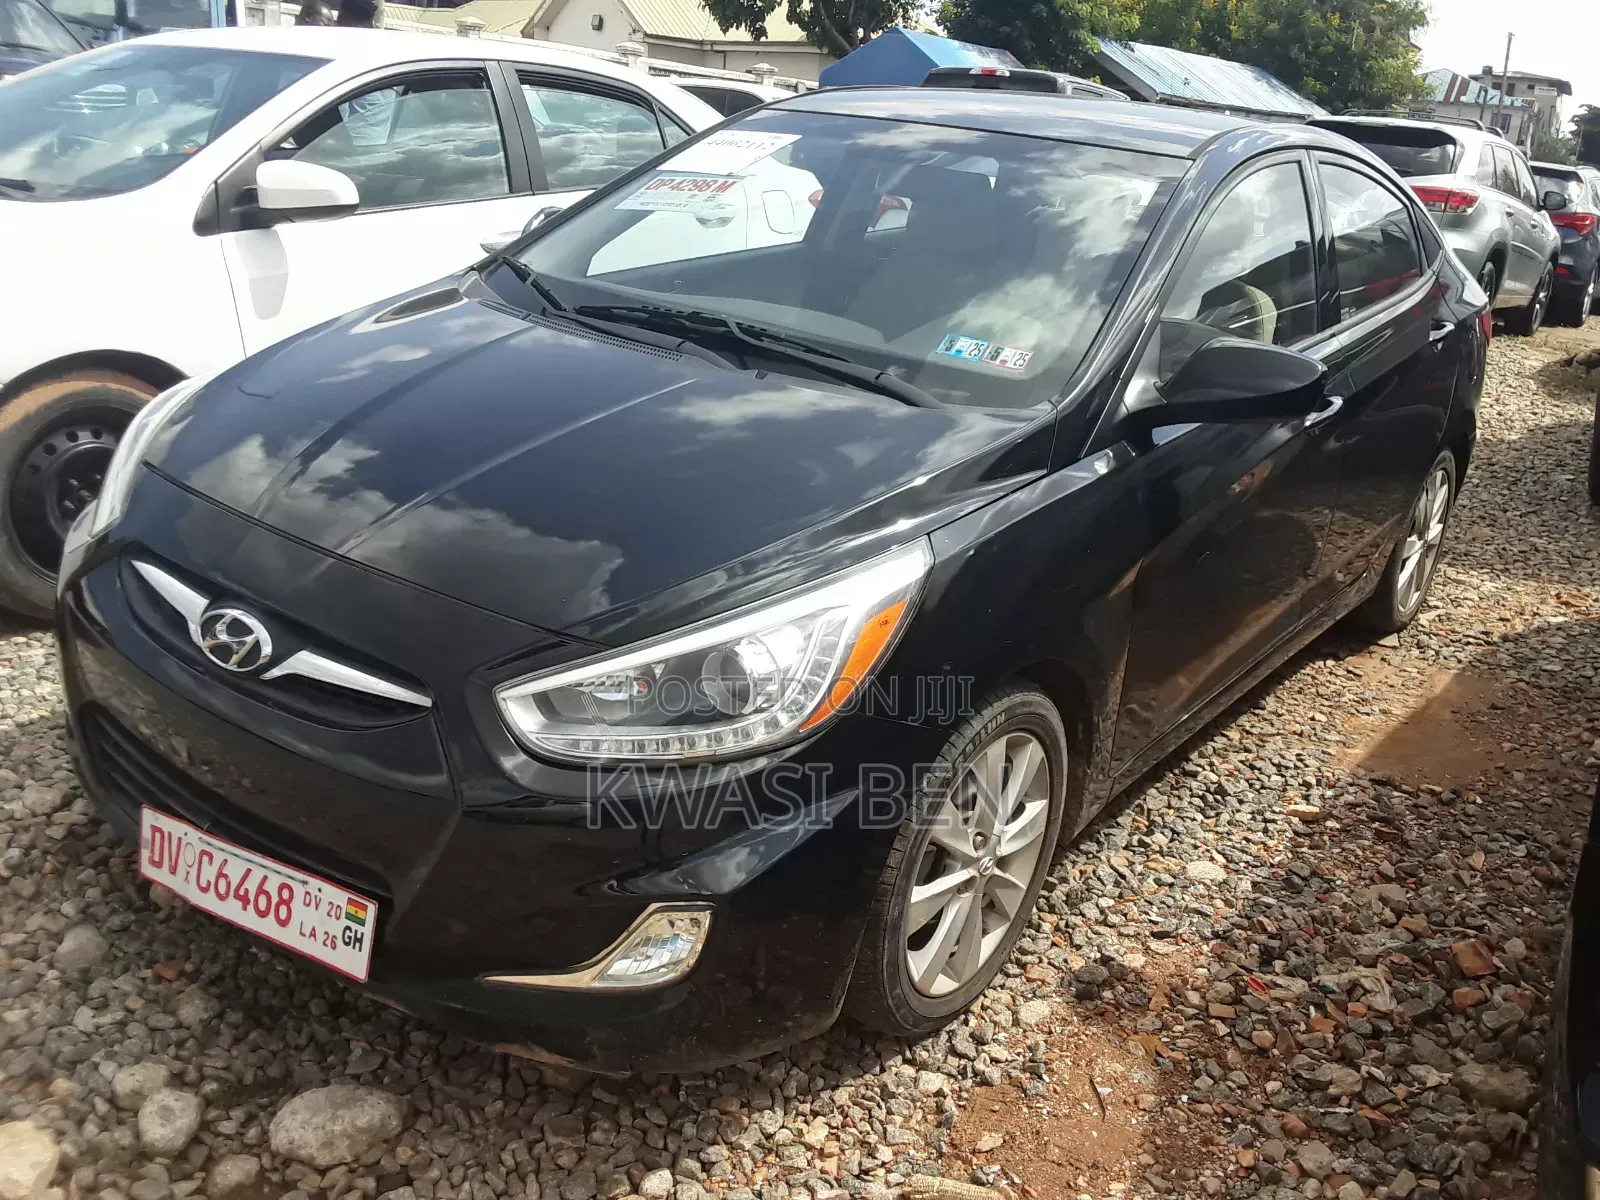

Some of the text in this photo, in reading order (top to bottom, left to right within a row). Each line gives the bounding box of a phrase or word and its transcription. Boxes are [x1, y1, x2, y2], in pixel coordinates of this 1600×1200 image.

[148, 824, 295, 928] DV C6468
[303, 890, 342, 921] DV 20
[299, 920, 338, 951] LA 26
[341, 925, 365, 952] GH
